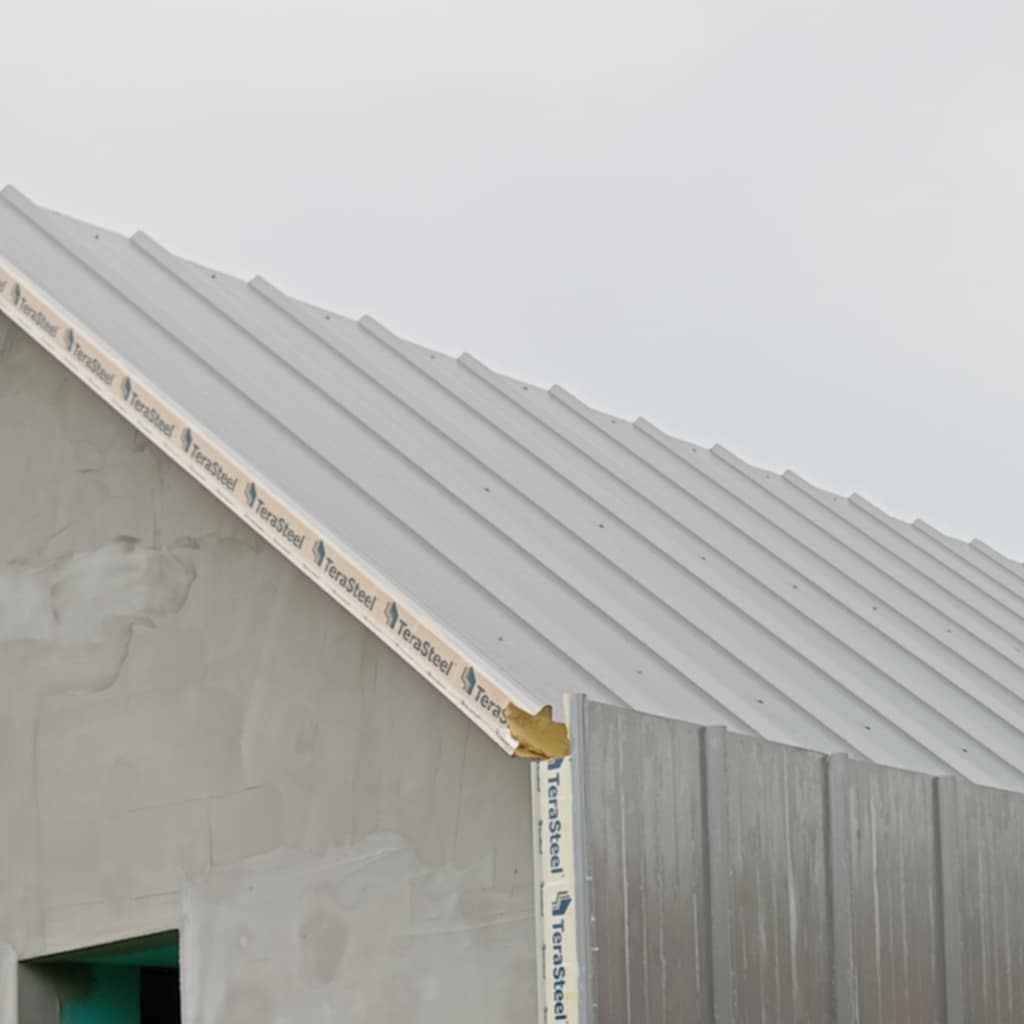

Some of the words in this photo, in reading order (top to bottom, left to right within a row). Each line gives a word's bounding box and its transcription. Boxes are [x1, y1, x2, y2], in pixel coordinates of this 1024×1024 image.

[73, 343, 115, 386] TeraSteel
[129, 391, 176, 438] TeraSteel
[189, 442, 239, 491] TeraSteel
[254, 499, 305, 550] TeraSteel
[322, 557, 377, 611] TeraSteel
[397, 619, 454, 676] TeraSteel
[547, 773, 564, 874] TeraSteel
[551, 919, 568, 1021] TeraSteel
